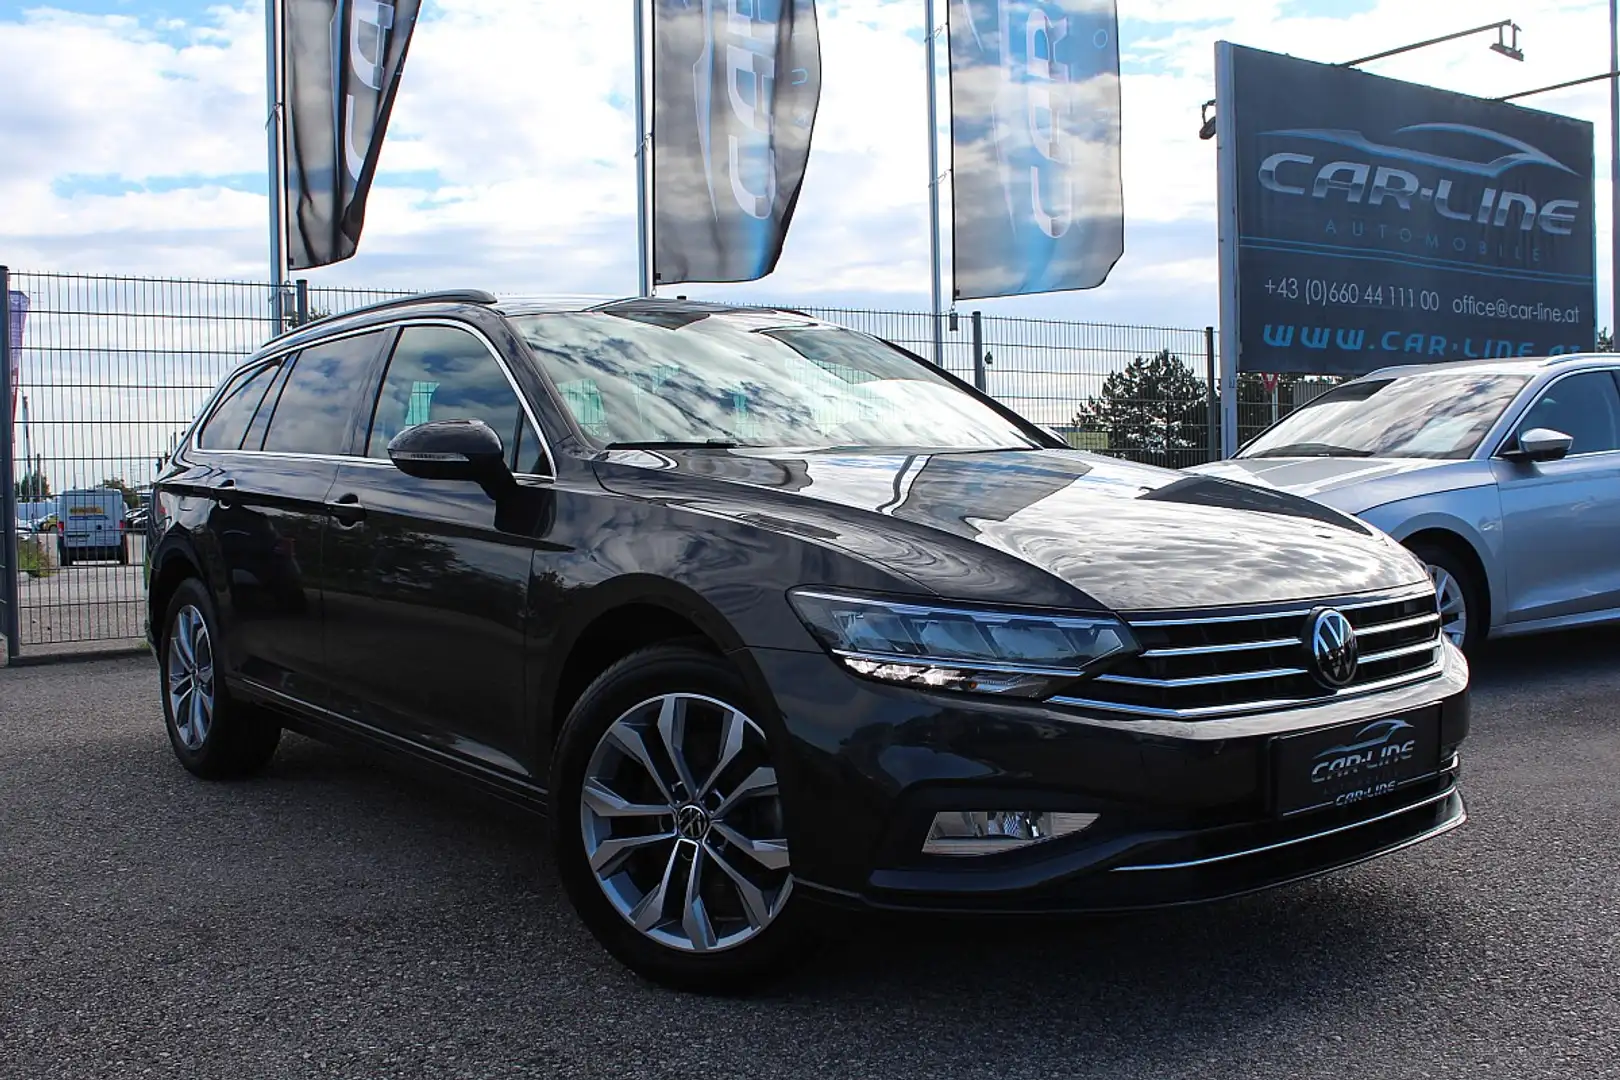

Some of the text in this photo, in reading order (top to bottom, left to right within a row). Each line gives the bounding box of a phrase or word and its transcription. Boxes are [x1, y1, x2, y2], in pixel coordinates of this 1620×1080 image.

[1325, 218, 1541, 262] AUTOMOBILE
[1265, 277, 1580, 323] +43 (0)660 44 111 00 office@car-line.at
